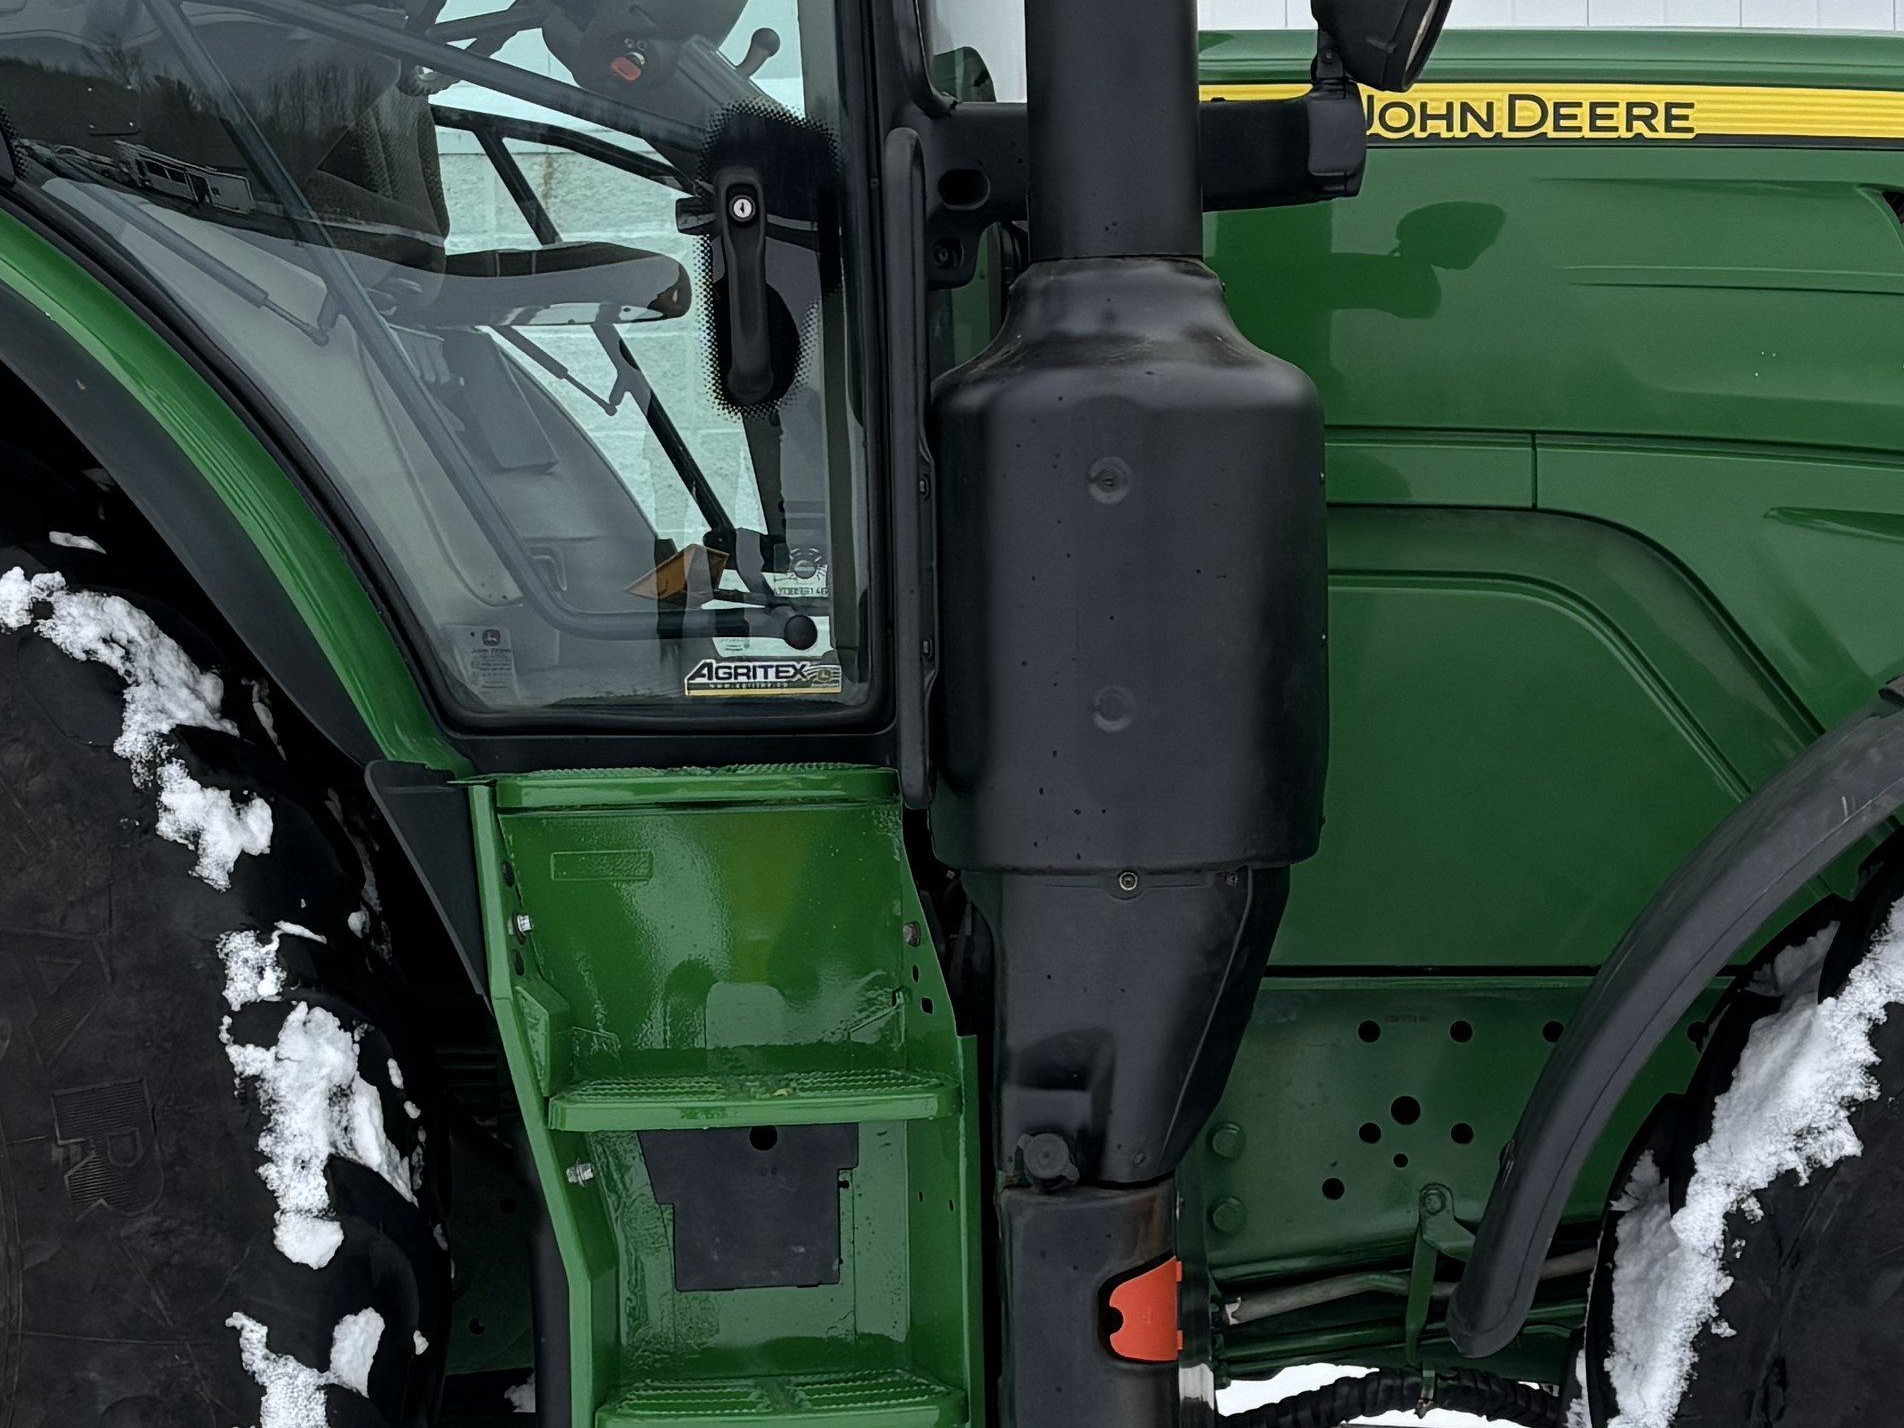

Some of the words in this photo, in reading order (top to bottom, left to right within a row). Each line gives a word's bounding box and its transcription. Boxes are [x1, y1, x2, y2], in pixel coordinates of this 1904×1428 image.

[1366, 94, 1494, 133] JOHN
[1507, 93, 1695, 134] DEERE
[686, 660, 808, 681] AGRITEX
